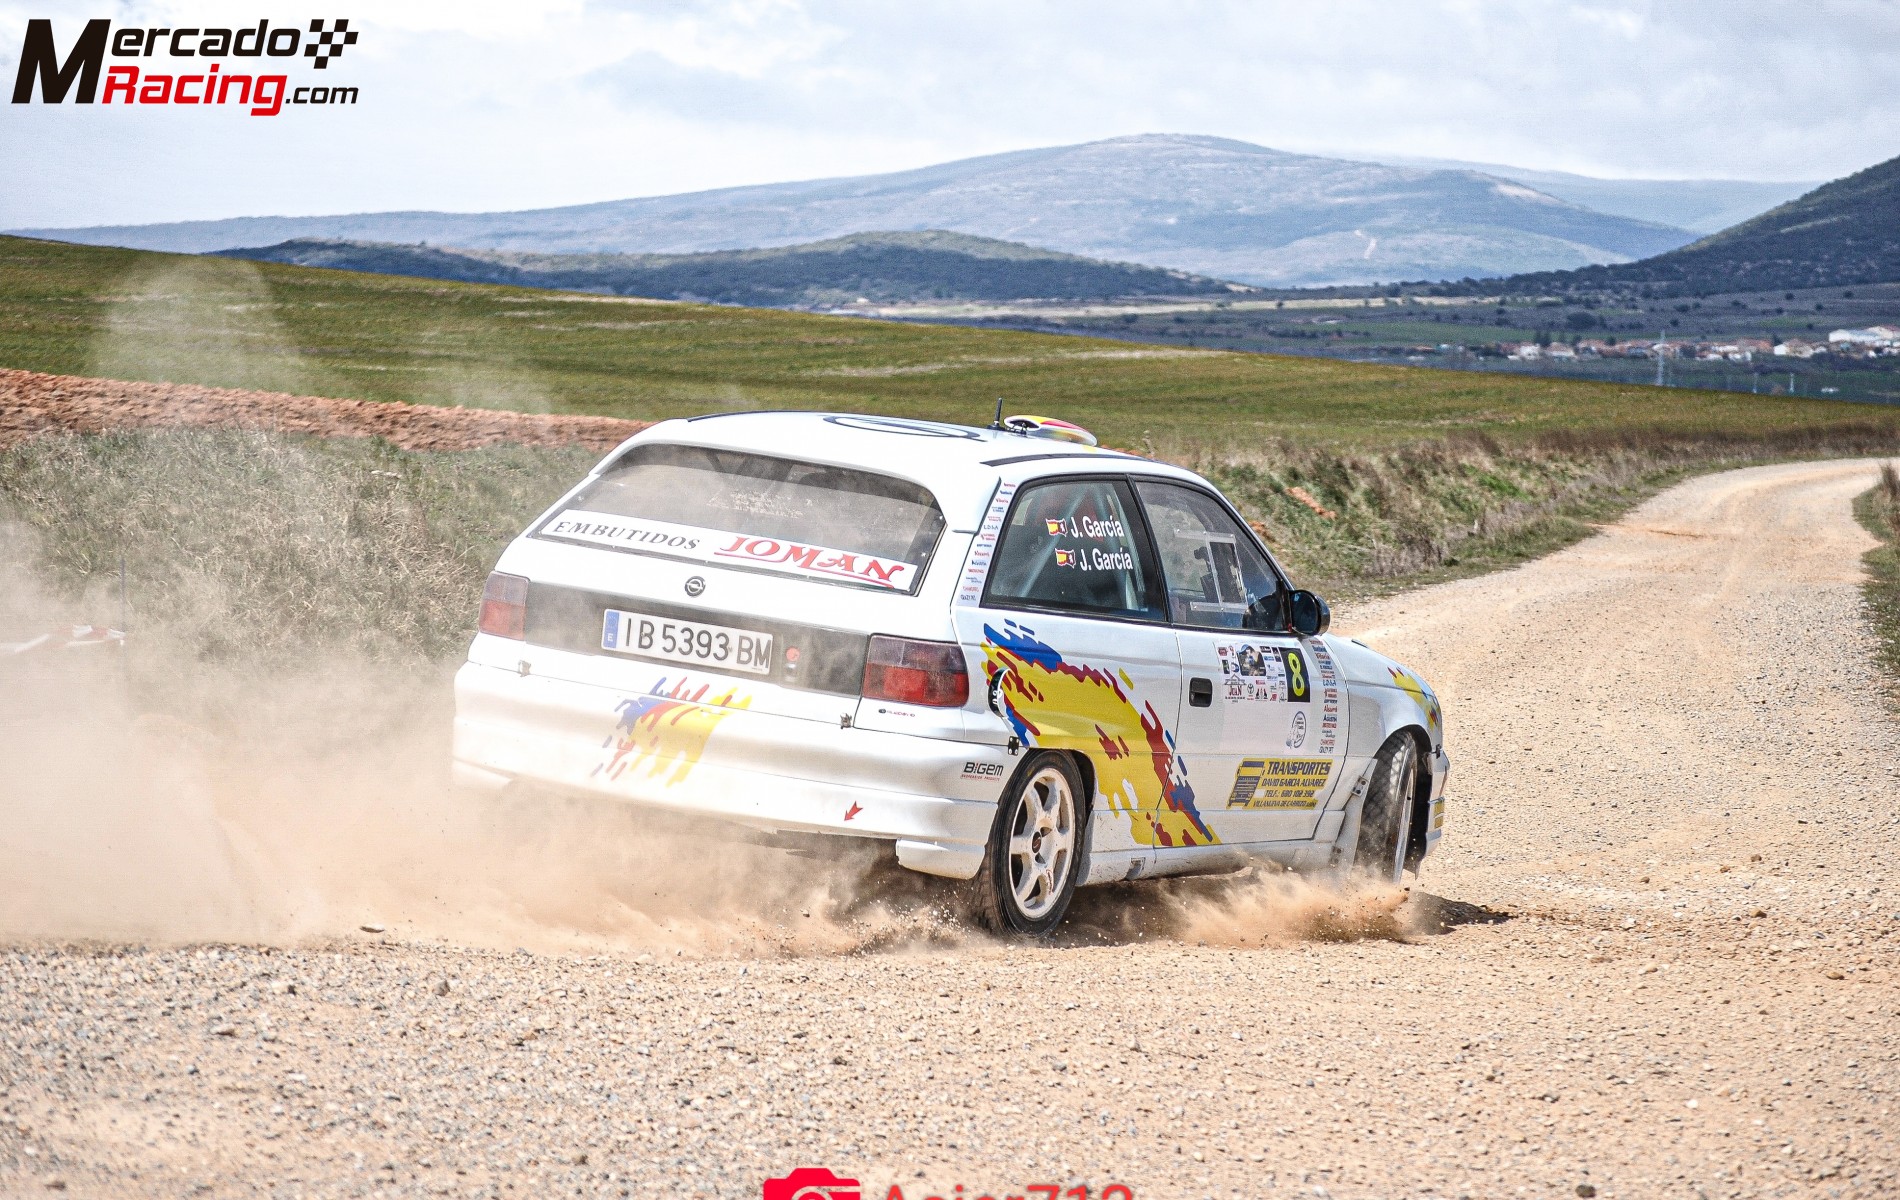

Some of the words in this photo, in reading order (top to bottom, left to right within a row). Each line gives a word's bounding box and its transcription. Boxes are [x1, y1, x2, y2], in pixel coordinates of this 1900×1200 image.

[1070, 517, 1083, 537] J.
[1083, 515, 1125, 538] García
[553, 520, 701, 550] EMBUTIDOS
[719, 536, 905, 584] JOMAN
[1079, 549, 1092, 571] J.
[1092, 547, 1133, 571] García
[661, 623, 730, 661] 5393
[736, 635, 772, 669] BM
[1288, 652, 1305, 697] 8
[1267, 761, 1332, 776] TRANSPORTES
[1261, 778, 1280, 787] DAVID
[1300, 778, 1327, 787] ALVAREZ
